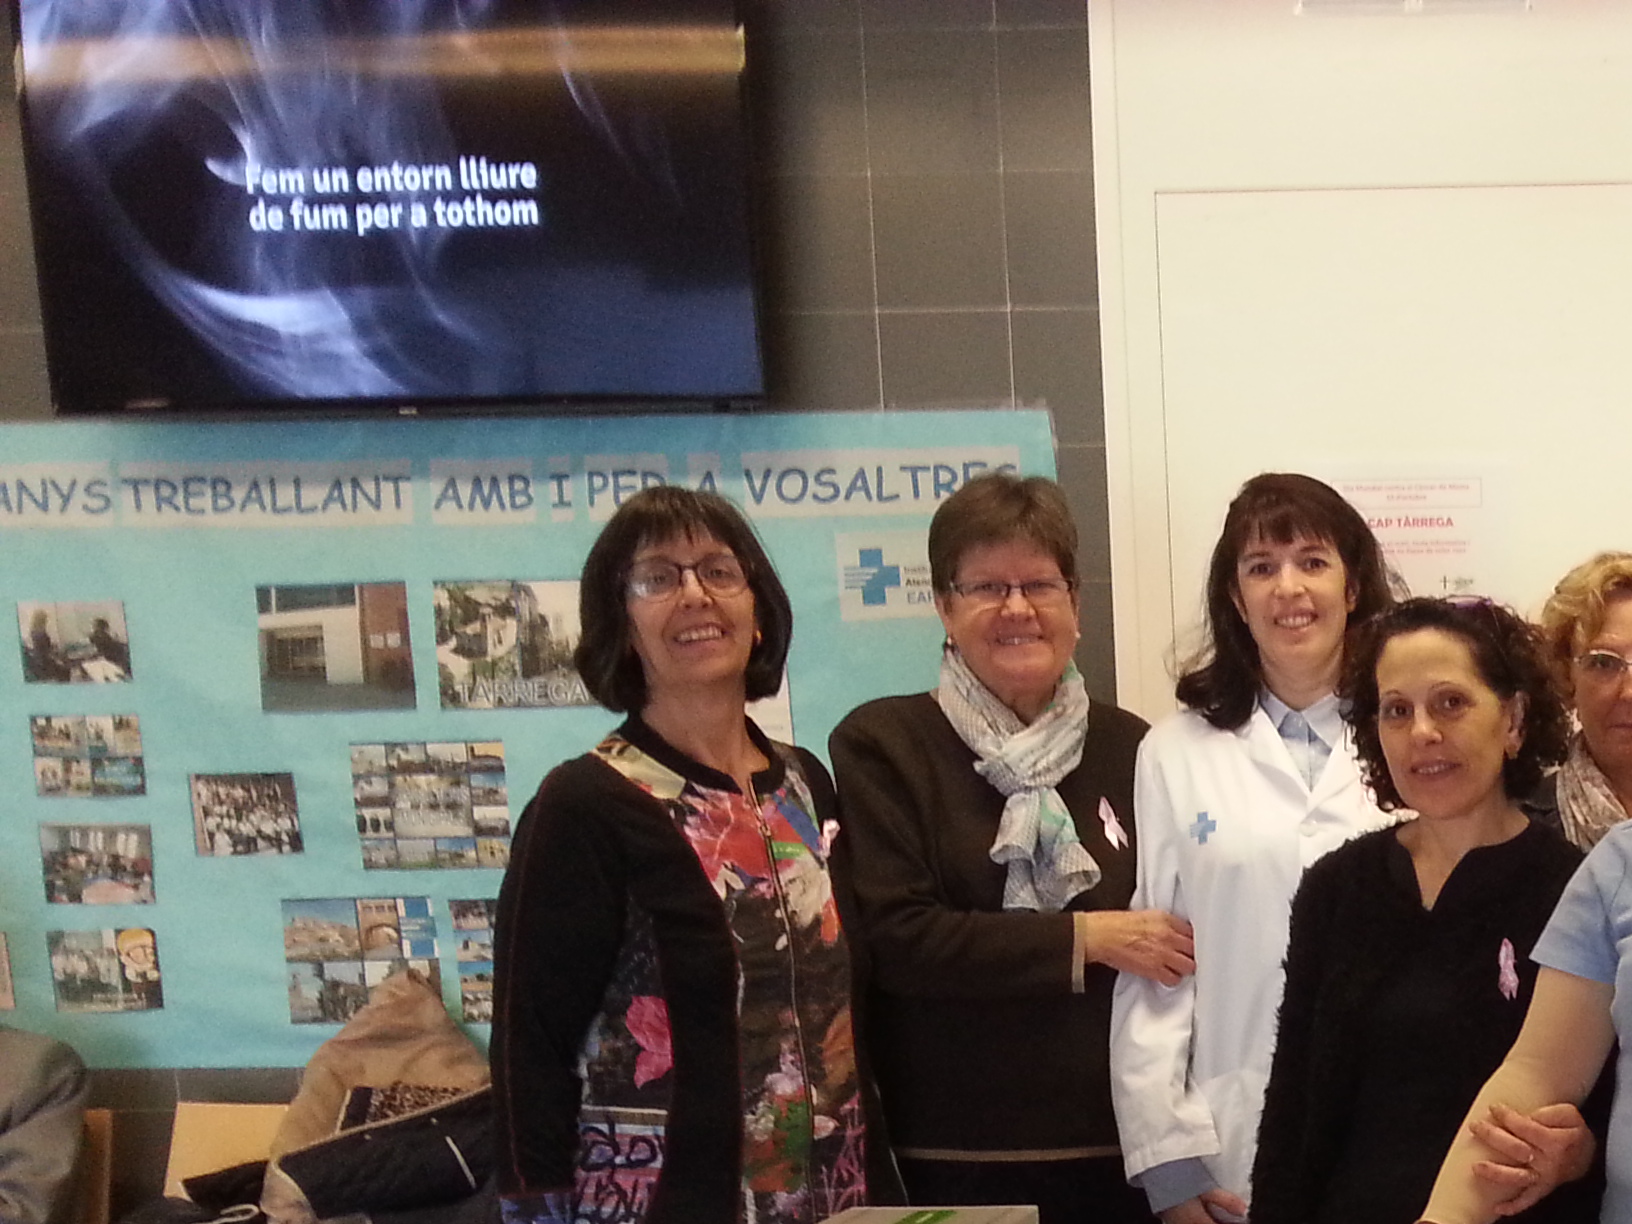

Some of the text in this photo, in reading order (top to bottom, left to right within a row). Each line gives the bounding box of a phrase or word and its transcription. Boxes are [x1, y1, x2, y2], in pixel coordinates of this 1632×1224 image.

[246, 155, 538, 195] Fem un entorn lliure
[249, 192, 539, 237] de fum per a tothom
[121, 475, 411, 514] TREBALLANT
[434, 473, 535, 512] AMB
[549, 473, 572, 509] I
[700, 470, 719, 495] A
[1368, 517, 1393, 528] CAP
